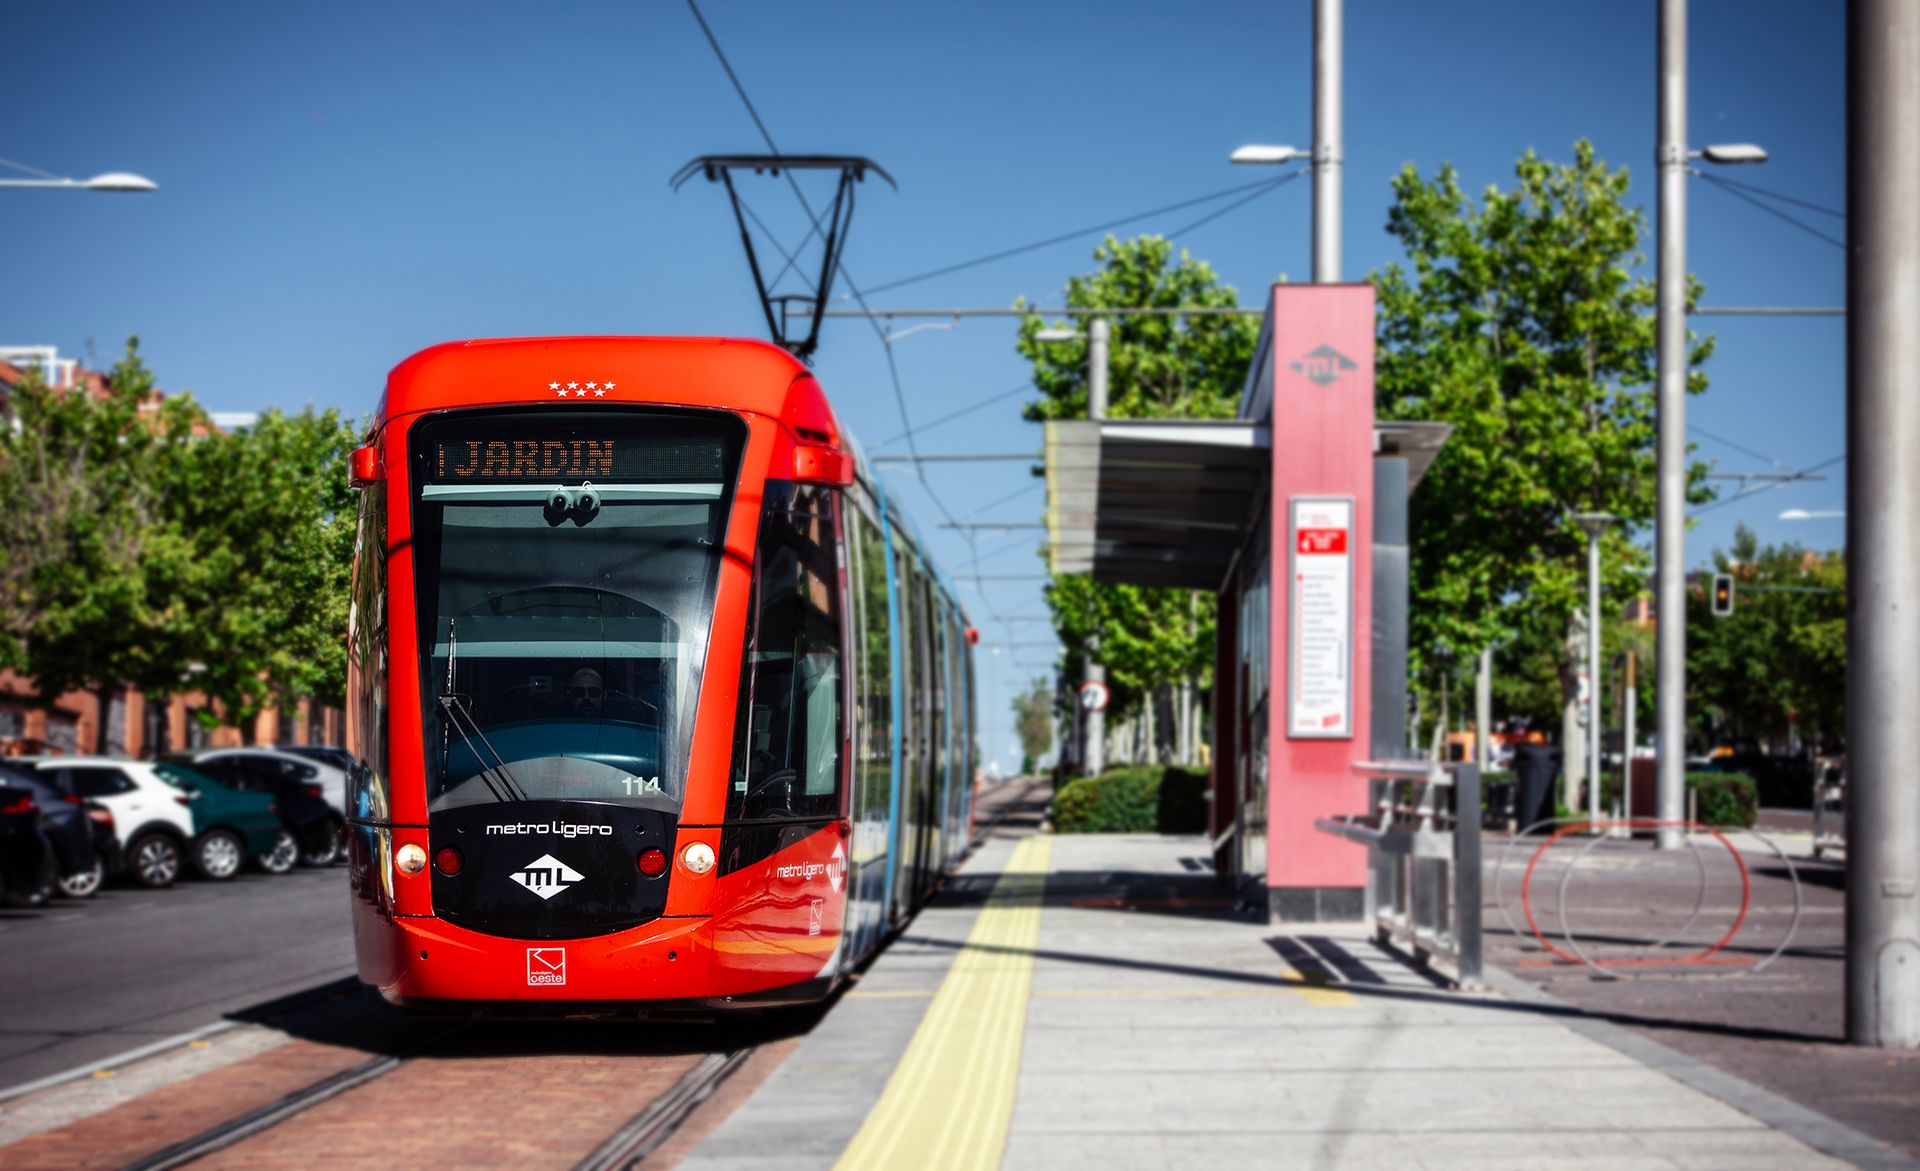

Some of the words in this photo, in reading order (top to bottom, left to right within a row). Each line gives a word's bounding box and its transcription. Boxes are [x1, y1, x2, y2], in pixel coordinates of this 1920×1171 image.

[621, 776, 662, 796] 114
[486, 822, 549, 835] metro
[552, 820, 612, 838] ligero
[530, 973, 562, 983] oeste
